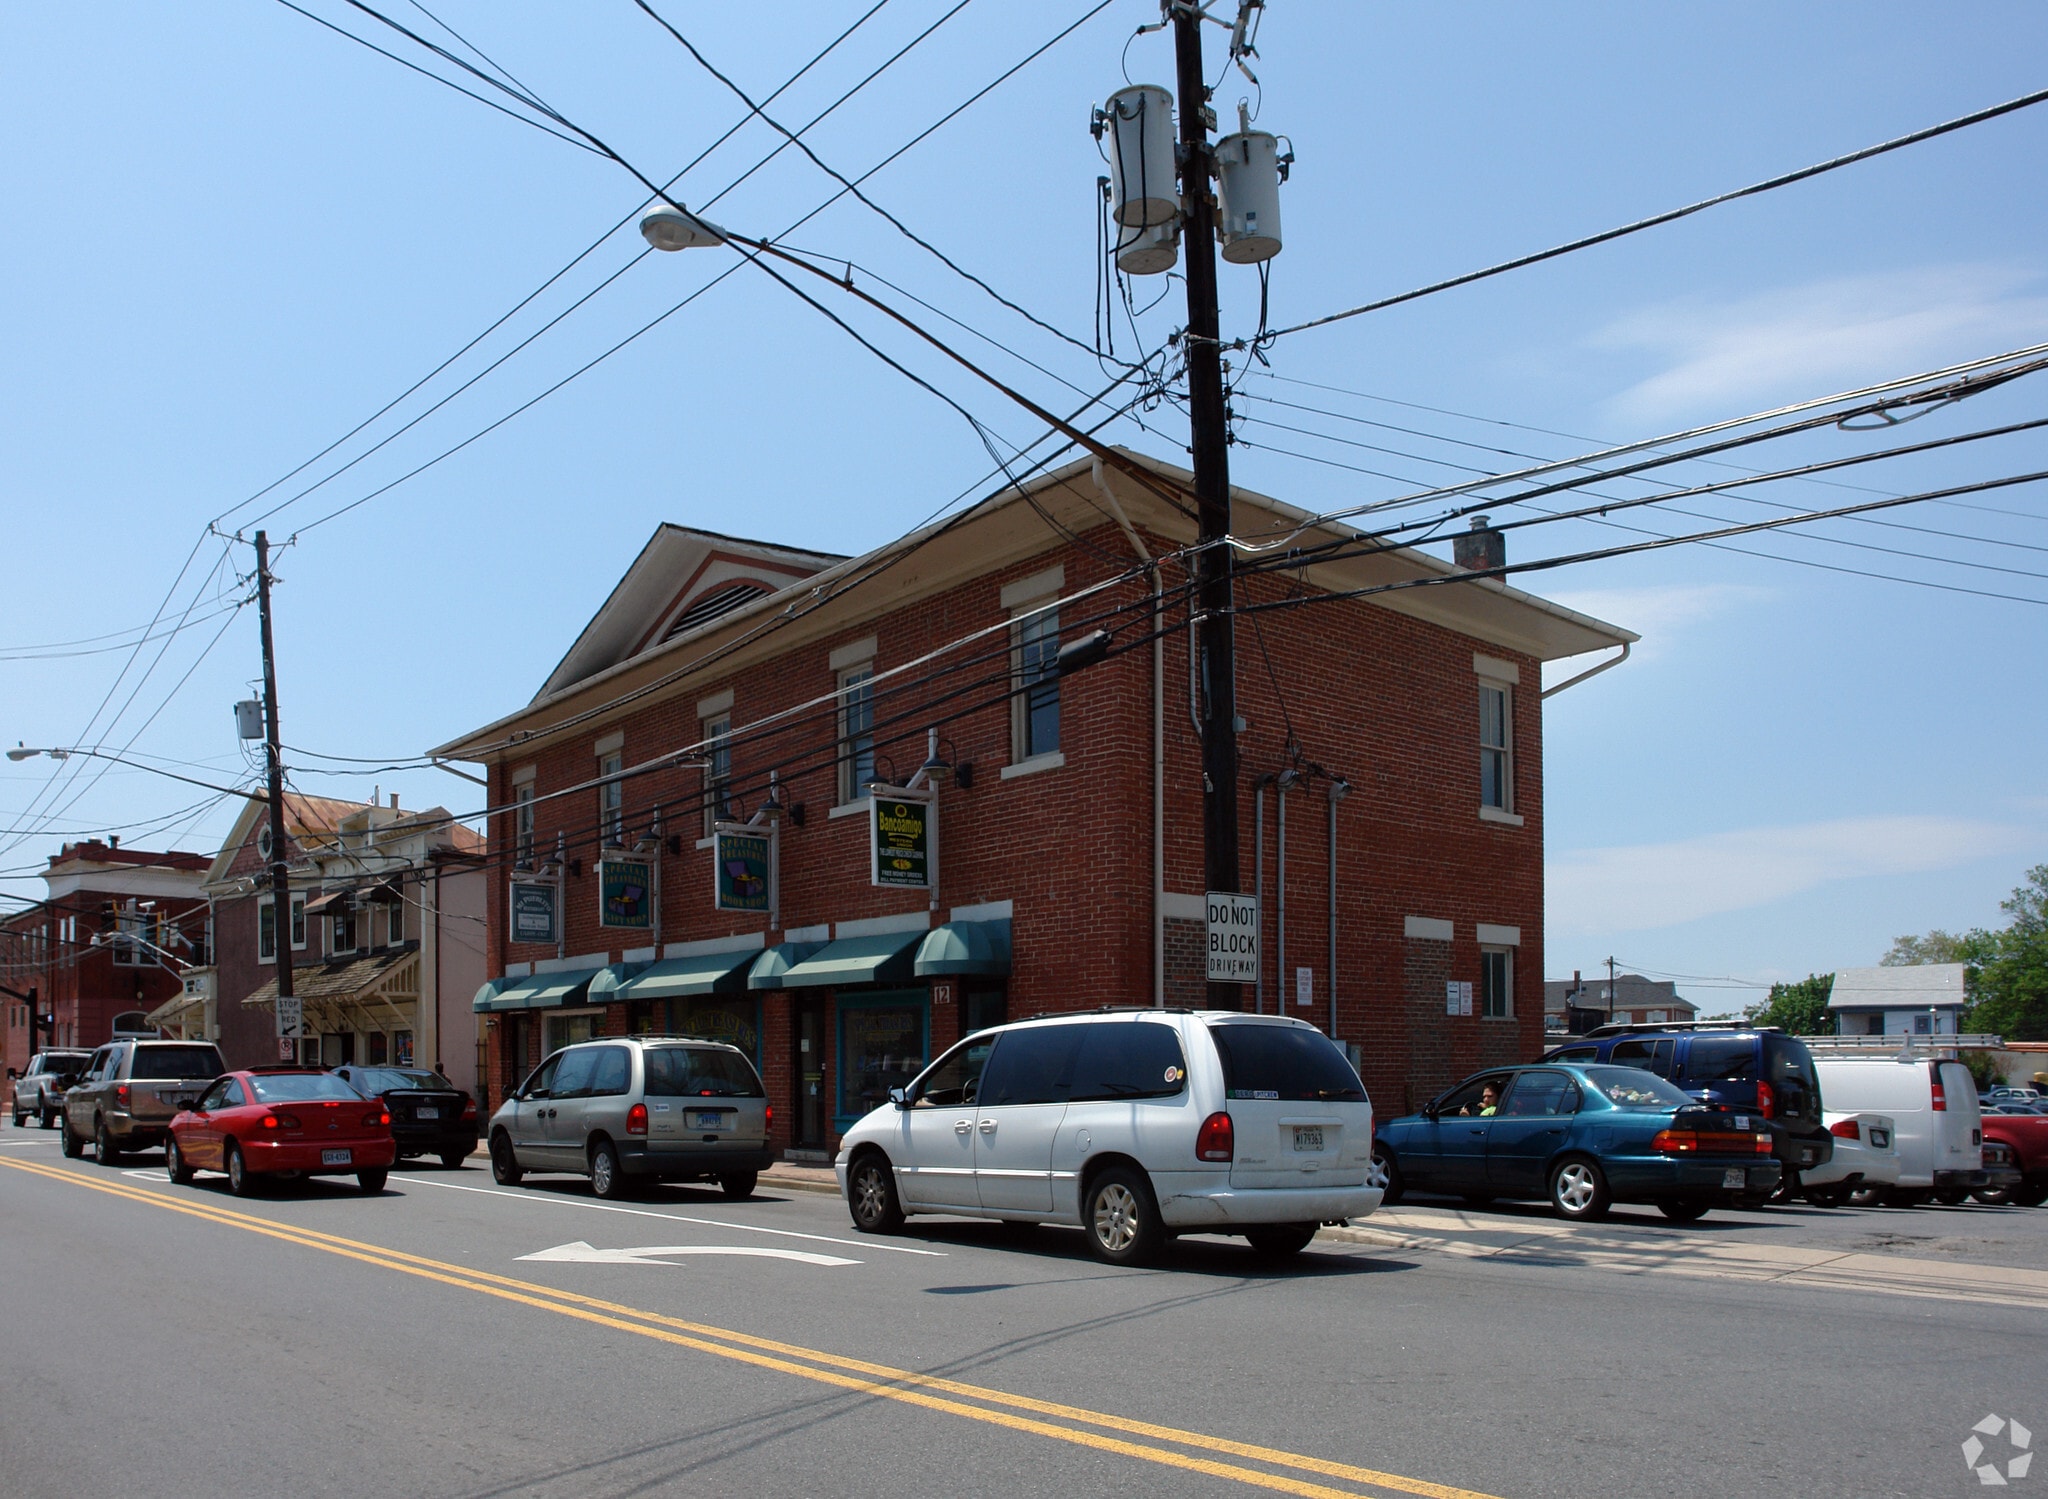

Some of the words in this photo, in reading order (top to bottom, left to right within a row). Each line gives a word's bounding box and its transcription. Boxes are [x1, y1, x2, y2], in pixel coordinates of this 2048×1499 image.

[879, 811, 922, 840] Bancoamigo
[720, 838, 763, 852] SPECIAL
[720, 848, 766, 864] TREASURES
[604, 864, 644, 878] SPECIAL
[721, 892, 743, 906] BOOK
[745, 895, 767, 907] SHOP
[1209, 905, 1228, 924] DO
[1231, 905, 1255, 926] NOT
[1210, 933, 1255, 954] BLOCK
[1210, 958, 1255, 974] DRIVEWAY
[936, 987, 948, 1002] 12
[279, 1000, 299, 1008] STOP
[282, 1015, 297, 1023] RED
